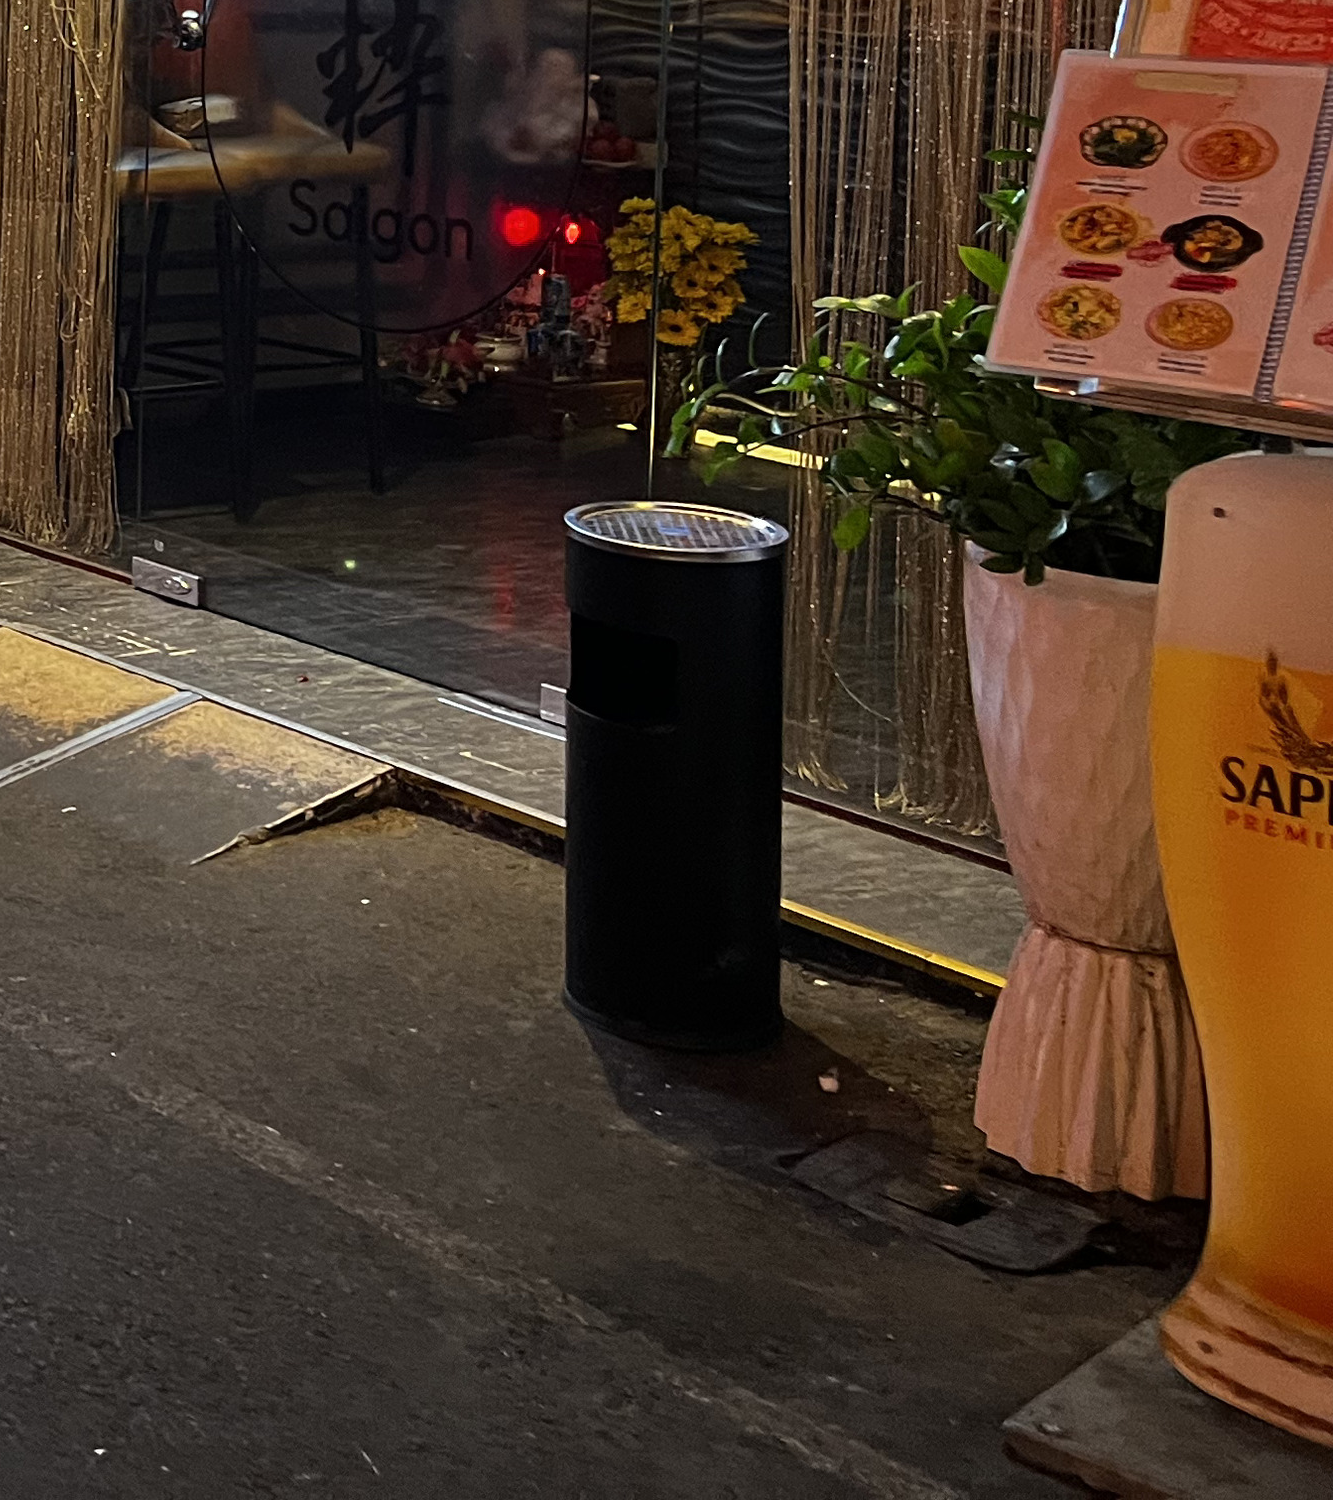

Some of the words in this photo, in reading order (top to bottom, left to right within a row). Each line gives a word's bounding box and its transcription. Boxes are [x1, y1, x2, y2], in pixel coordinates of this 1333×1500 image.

[288, 178, 475, 264] Saigon
[1220, 755, 1333, 826] SAP
[1224, 807, 1333, 851] PREMI
